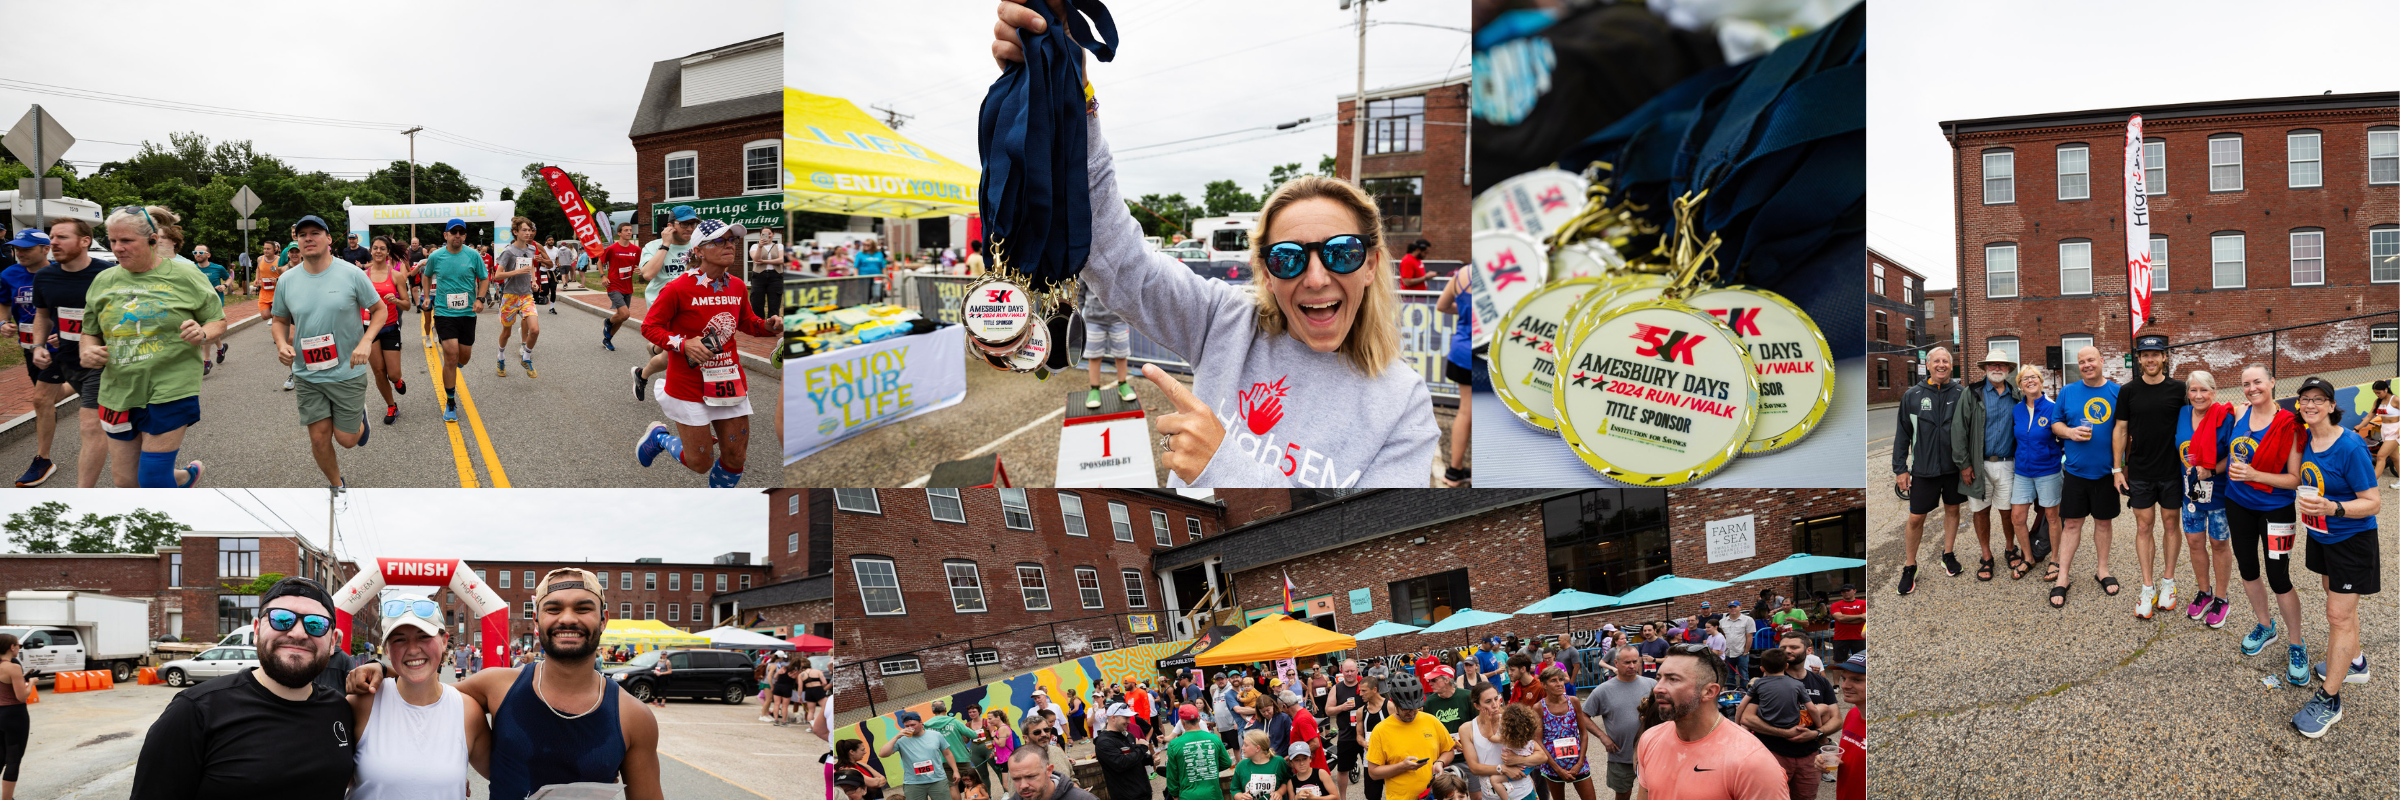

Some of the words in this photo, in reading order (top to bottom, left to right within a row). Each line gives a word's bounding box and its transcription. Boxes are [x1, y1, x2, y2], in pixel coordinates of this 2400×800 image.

[805, 125, 944, 166] LIFE
[373, 208, 412, 219] ENJOY
[417, 206, 451, 218] YOUR
[456, 205, 486, 217] LIFE
[558, 191, 601, 247] START
[730, 215, 779, 226] Landing
[664, 264, 685, 273] IPA
[691, 295, 742, 306] AMESBURY
[985, 290, 1013, 303] 5K
[1628, 322, 1708, 366] 5K
[1759, 342, 1803, 360] DAYS
[307, 347, 332, 363] 126
[804, 345, 910, 394] ENJOY
[1578, 353, 1680, 389] AMESBURY
[1683, 373, 1729, 401] DAYS
[715, 381, 736, 397] 59
[808, 369, 900, 415] YOUR
[1606, 380, 1645, 398] 2024
[842, 383, 914, 428] LIFE
[1605, 400, 1638, 421] TITLE
[1640, 408, 1692, 434] SPONSOR
[1100, 427, 1112, 458] 1
[1079, 458, 1120, 470] SPONSORED
[1122, 456, 1131, 465] BY
[1712, 522, 1747, 536] FARM
[1723, 532, 1747, 545] SEA
[2275, 536, 2292, 550] 174
[387, 562, 448, 577] FINISH
[1560, 746, 1574, 756] 175
[1255, 782, 1271, 791] 1790
